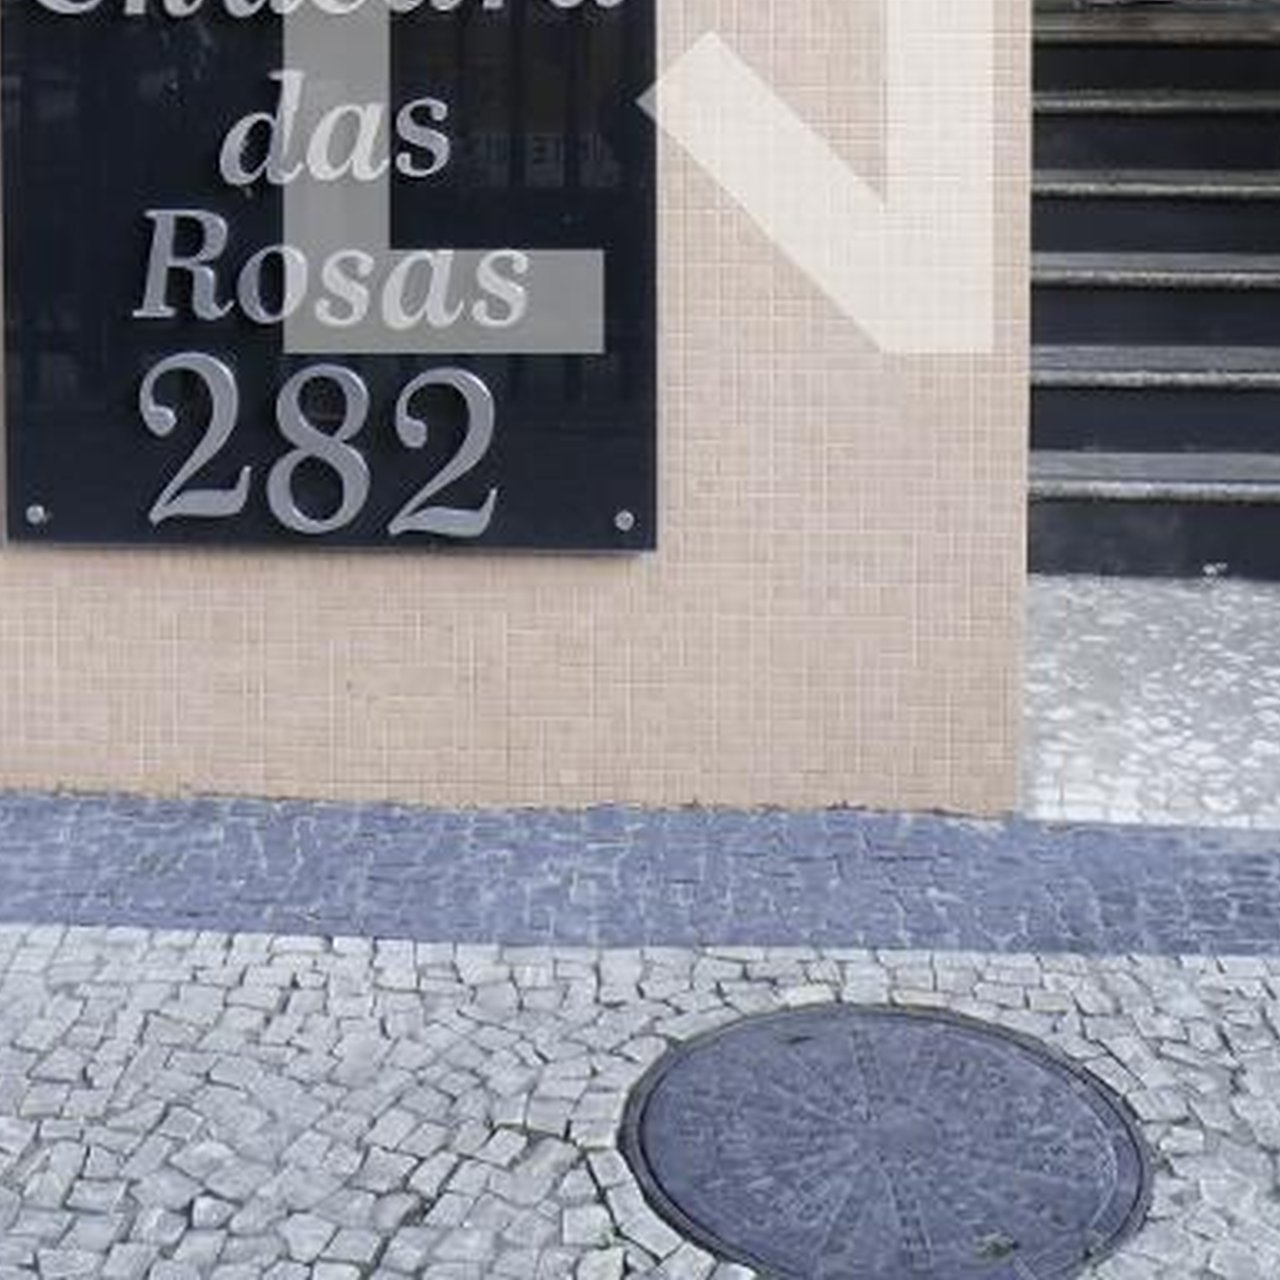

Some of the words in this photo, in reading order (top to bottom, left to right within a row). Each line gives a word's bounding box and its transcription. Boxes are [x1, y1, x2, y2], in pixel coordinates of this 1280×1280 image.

[219, 70, 452, 186] das
[132, 209, 530, 330] Rosas
[139, 352, 498, 538] 282
